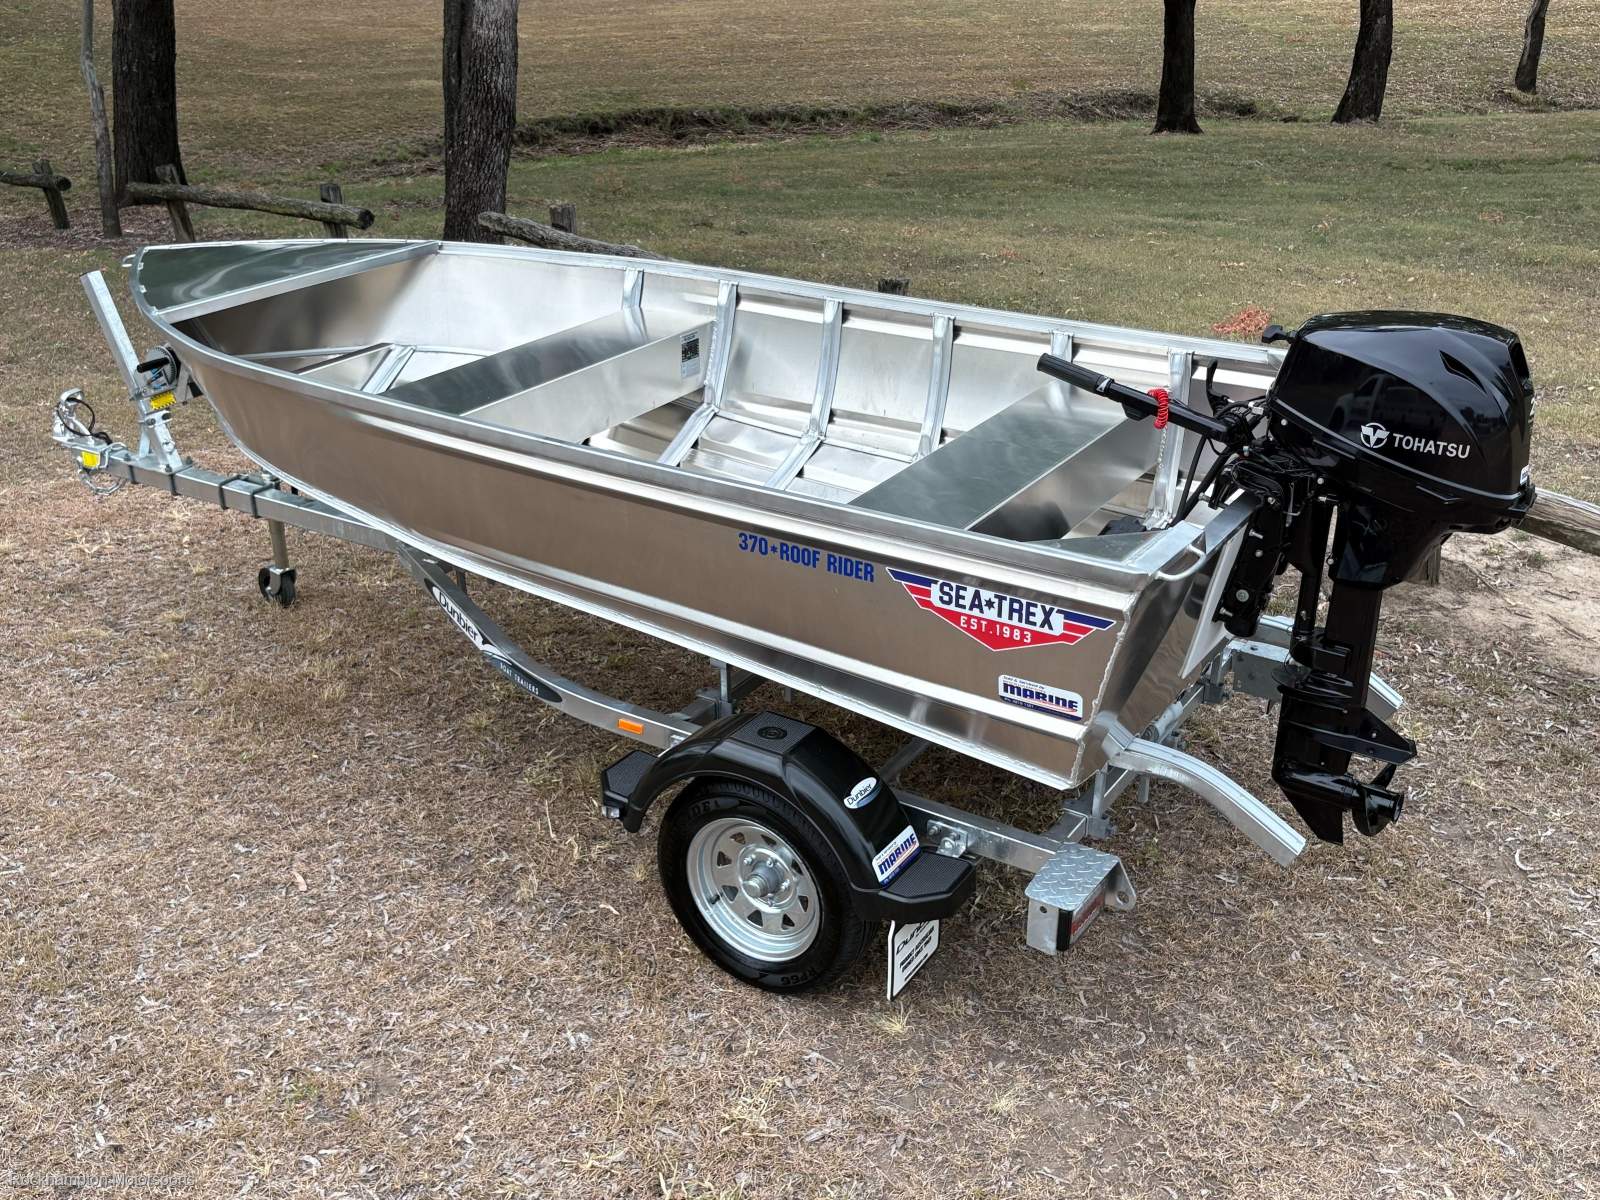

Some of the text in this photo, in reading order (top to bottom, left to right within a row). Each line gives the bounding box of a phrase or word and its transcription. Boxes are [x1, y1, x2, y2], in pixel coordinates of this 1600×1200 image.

[1392, 433, 1471, 459] TOHATSU
[738, 532, 875, 583] 370 ROOF RIDER
[439, 591, 478, 640] Dunbier
[846, 783, 872, 806] Dunbier
